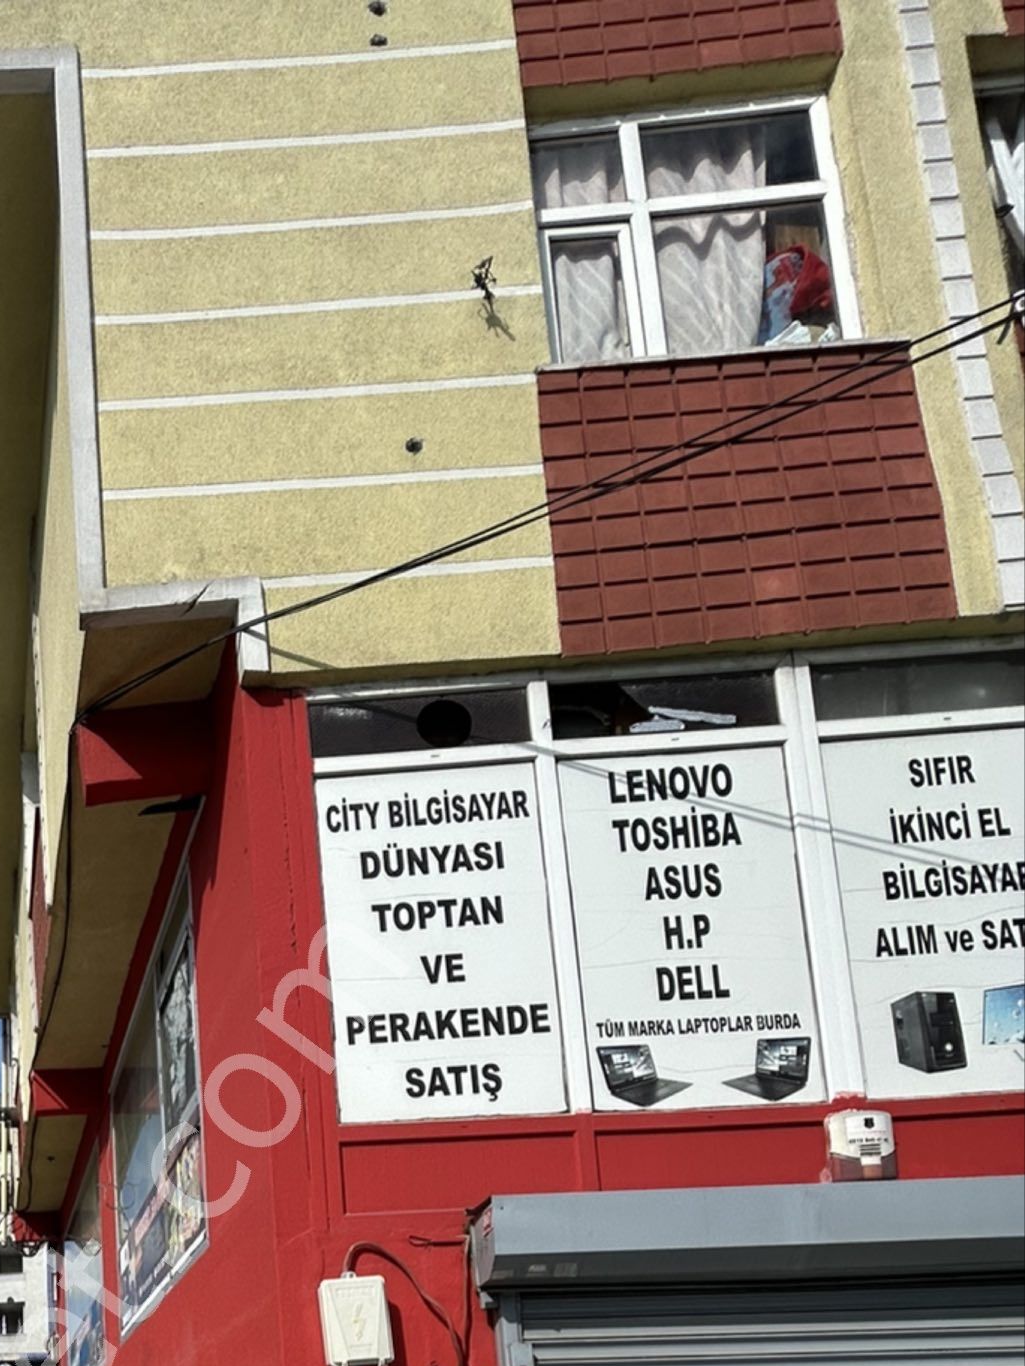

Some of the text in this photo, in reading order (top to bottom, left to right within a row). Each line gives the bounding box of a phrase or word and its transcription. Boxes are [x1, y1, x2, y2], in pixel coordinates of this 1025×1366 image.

[608, 763, 733, 804] LENOVO
[908, 755, 975, 787] SIFIR
[326, 789, 530, 833] CİTY BİLGİSAYAR
[612, 806, 742, 852] TOSHİBA
[889, 802, 1011, 844] İKİNCİ EL
[360, 841, 505, 879] DÜNYASI
[645, 863, 722, 901] ASUS
[371, 895, 504, 932] TOPTAN
[663, 914, 711, 950] H.P
[875, 924, 938, 958] ALIM
[944, 930, 974, 953] ve
[420, 953, 466, 984] VE
[656, 964, 730, 1001] DELL
[346, 1003, 551, 1045] PERAKENDE
[596, 1013, 801, 1038] TÜM MARKA LAPTOPLAR BURDA
[405, 1063, 503, 1102] SATIŞ
